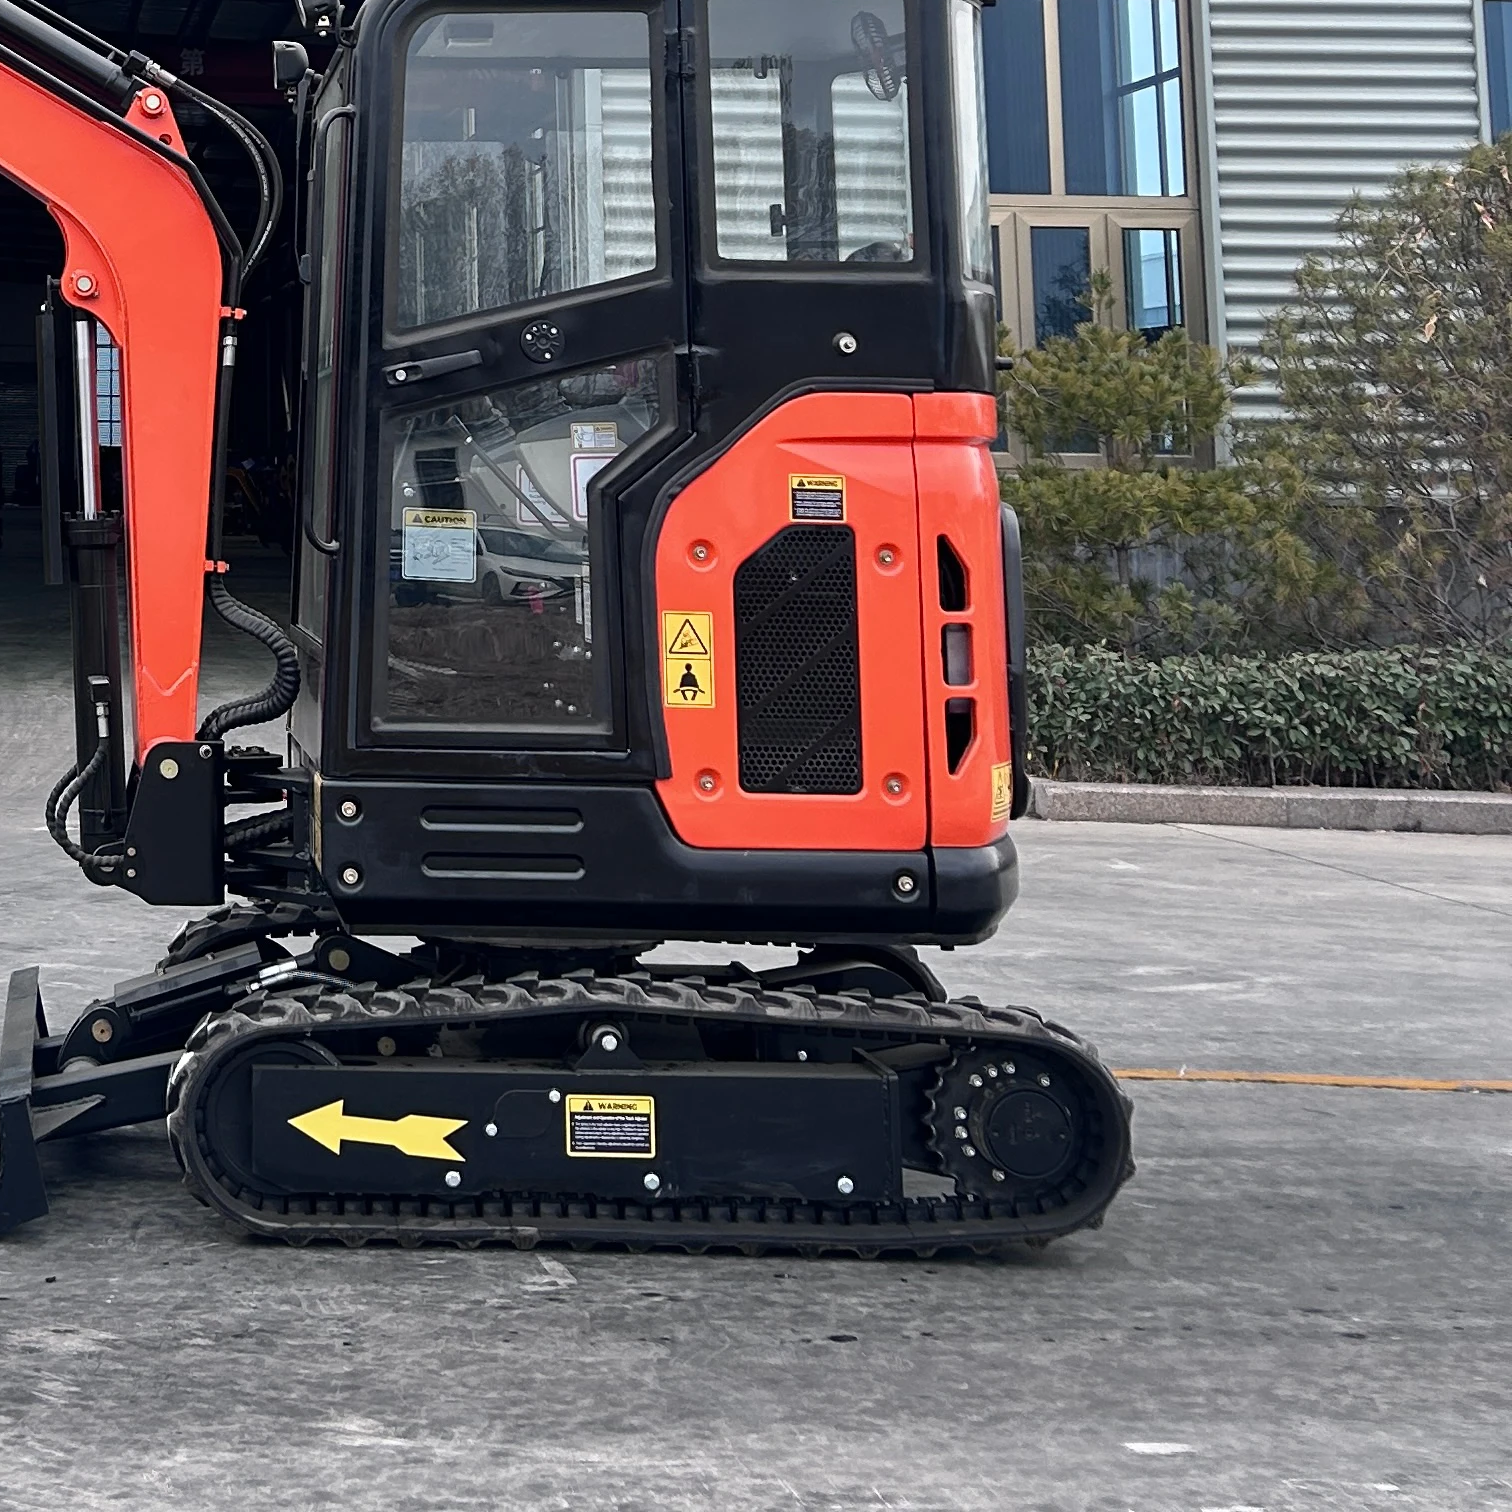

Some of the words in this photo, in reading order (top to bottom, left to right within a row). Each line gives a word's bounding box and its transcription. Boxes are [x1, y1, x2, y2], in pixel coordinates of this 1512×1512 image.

[179, 47, 206, 76] 第
[424, 515, 467, 524] CAUTION
[598, 1102, 638, 1111] WARNING
